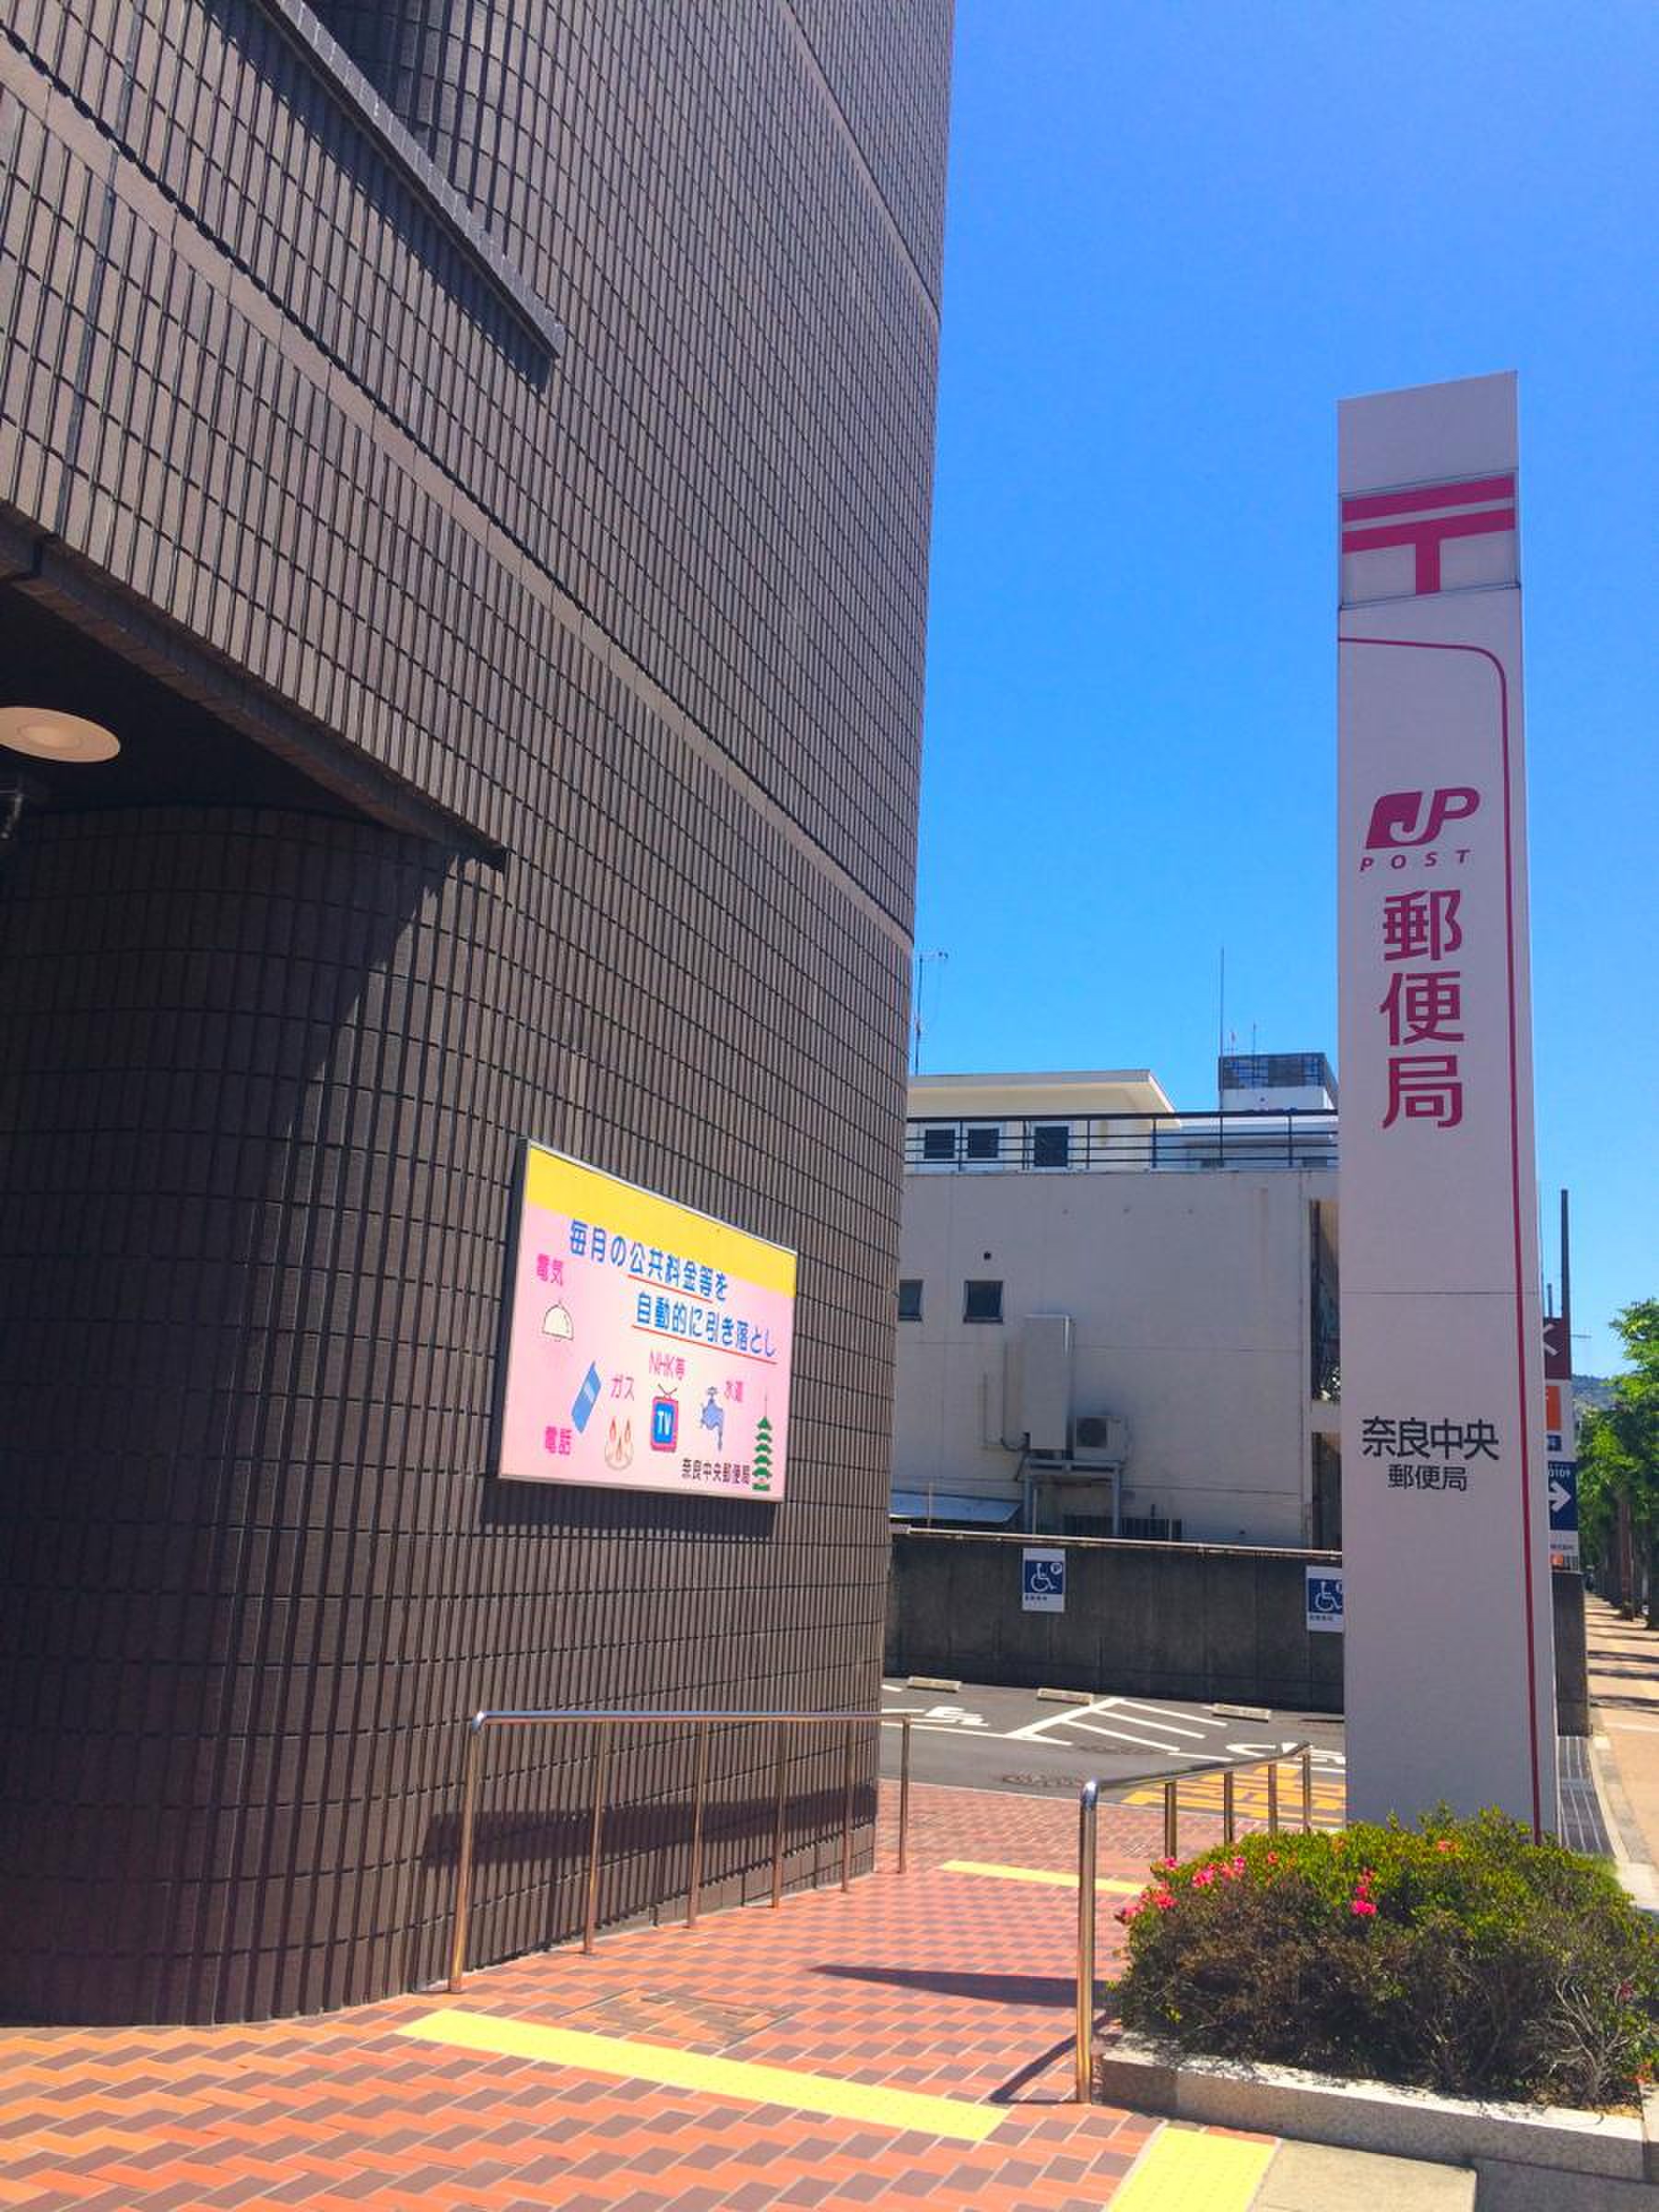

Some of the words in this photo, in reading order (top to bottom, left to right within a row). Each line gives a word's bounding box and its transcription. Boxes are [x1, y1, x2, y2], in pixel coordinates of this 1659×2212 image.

[1359, 849, 1471, 872] POST
[1380, 889, 1465, 1129] 郵便局
[536, 1253, 564, 1287] 電気
[570, 1218, 728, 1301] 毎月の公共料金等を
[636, 1291, 776, 1358] 自動的に引き落とし
[611, 1374, 635, 1401] ガス
[657, 1410, 672, 1436] TV
[1362, 1416, 1500, 1461] 奈良中央
[1387, 1464, 1467, 1491] 郵便局
